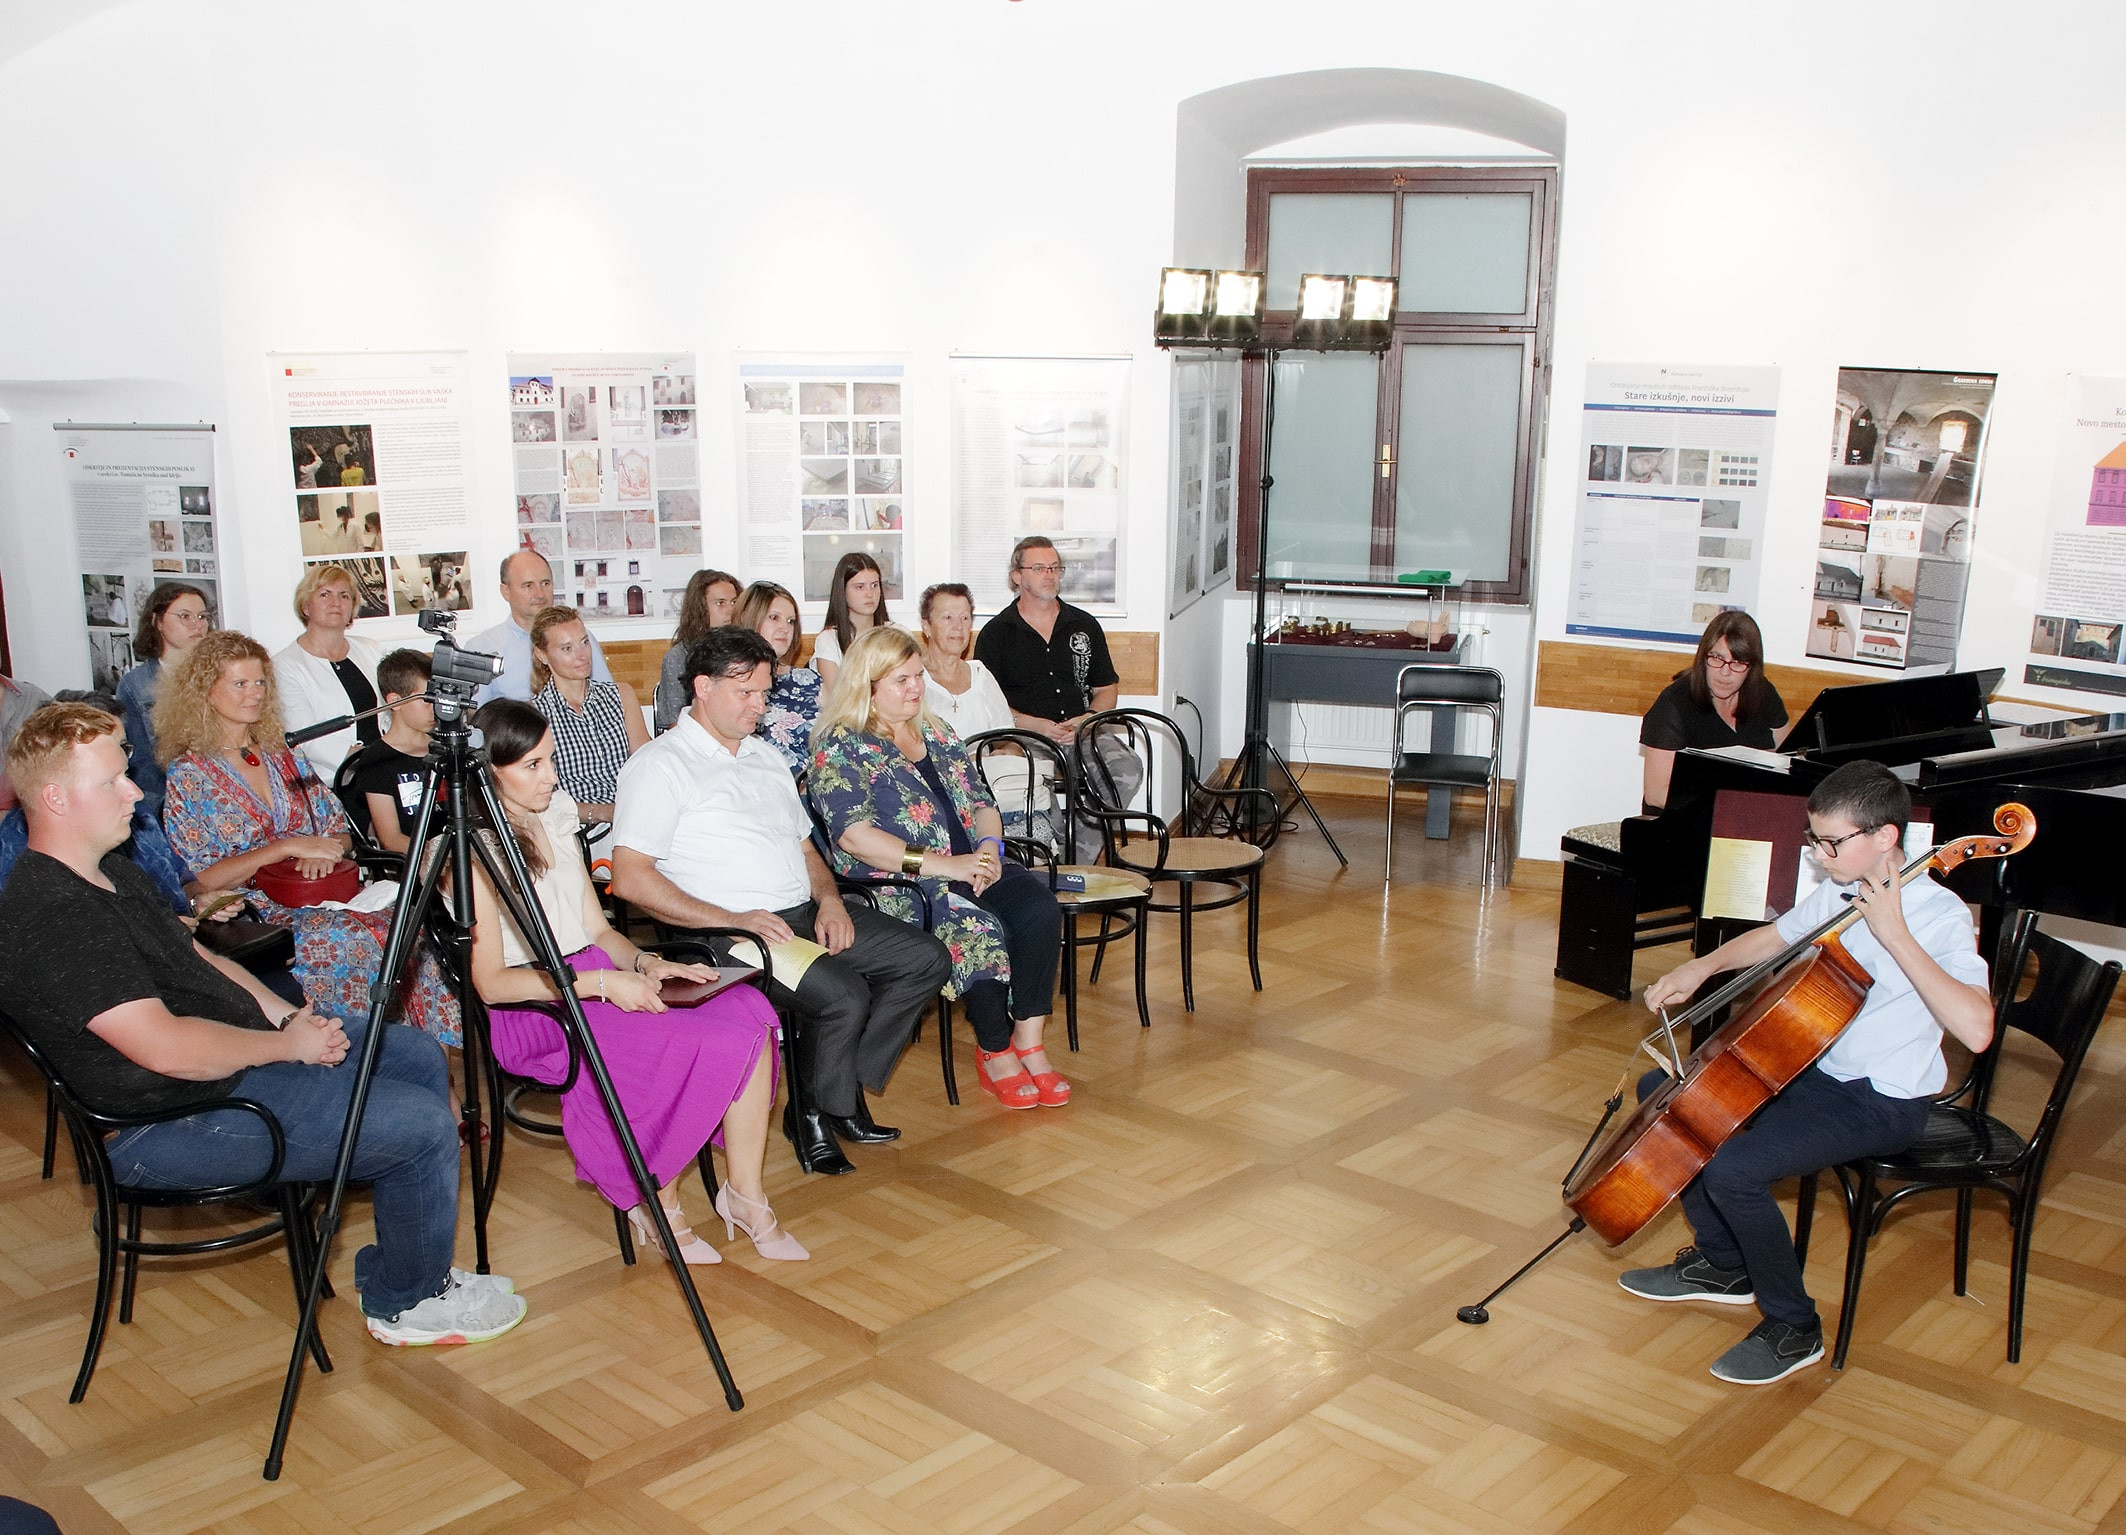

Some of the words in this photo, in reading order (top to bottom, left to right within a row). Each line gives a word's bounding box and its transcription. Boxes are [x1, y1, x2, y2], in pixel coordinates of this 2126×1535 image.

[388, 388, 418, 396] STENSKIH
[1624, 391, 1647, 400] Stare
[1649, 391, 1689, 403] izkušnje,
[1691, 393, 1710, 402] novi
[1712, 394, 1735, 403] izzivi
[355, 398, 379, 406] JOŽETA
[2076, 418, 2099, 427] Novo
